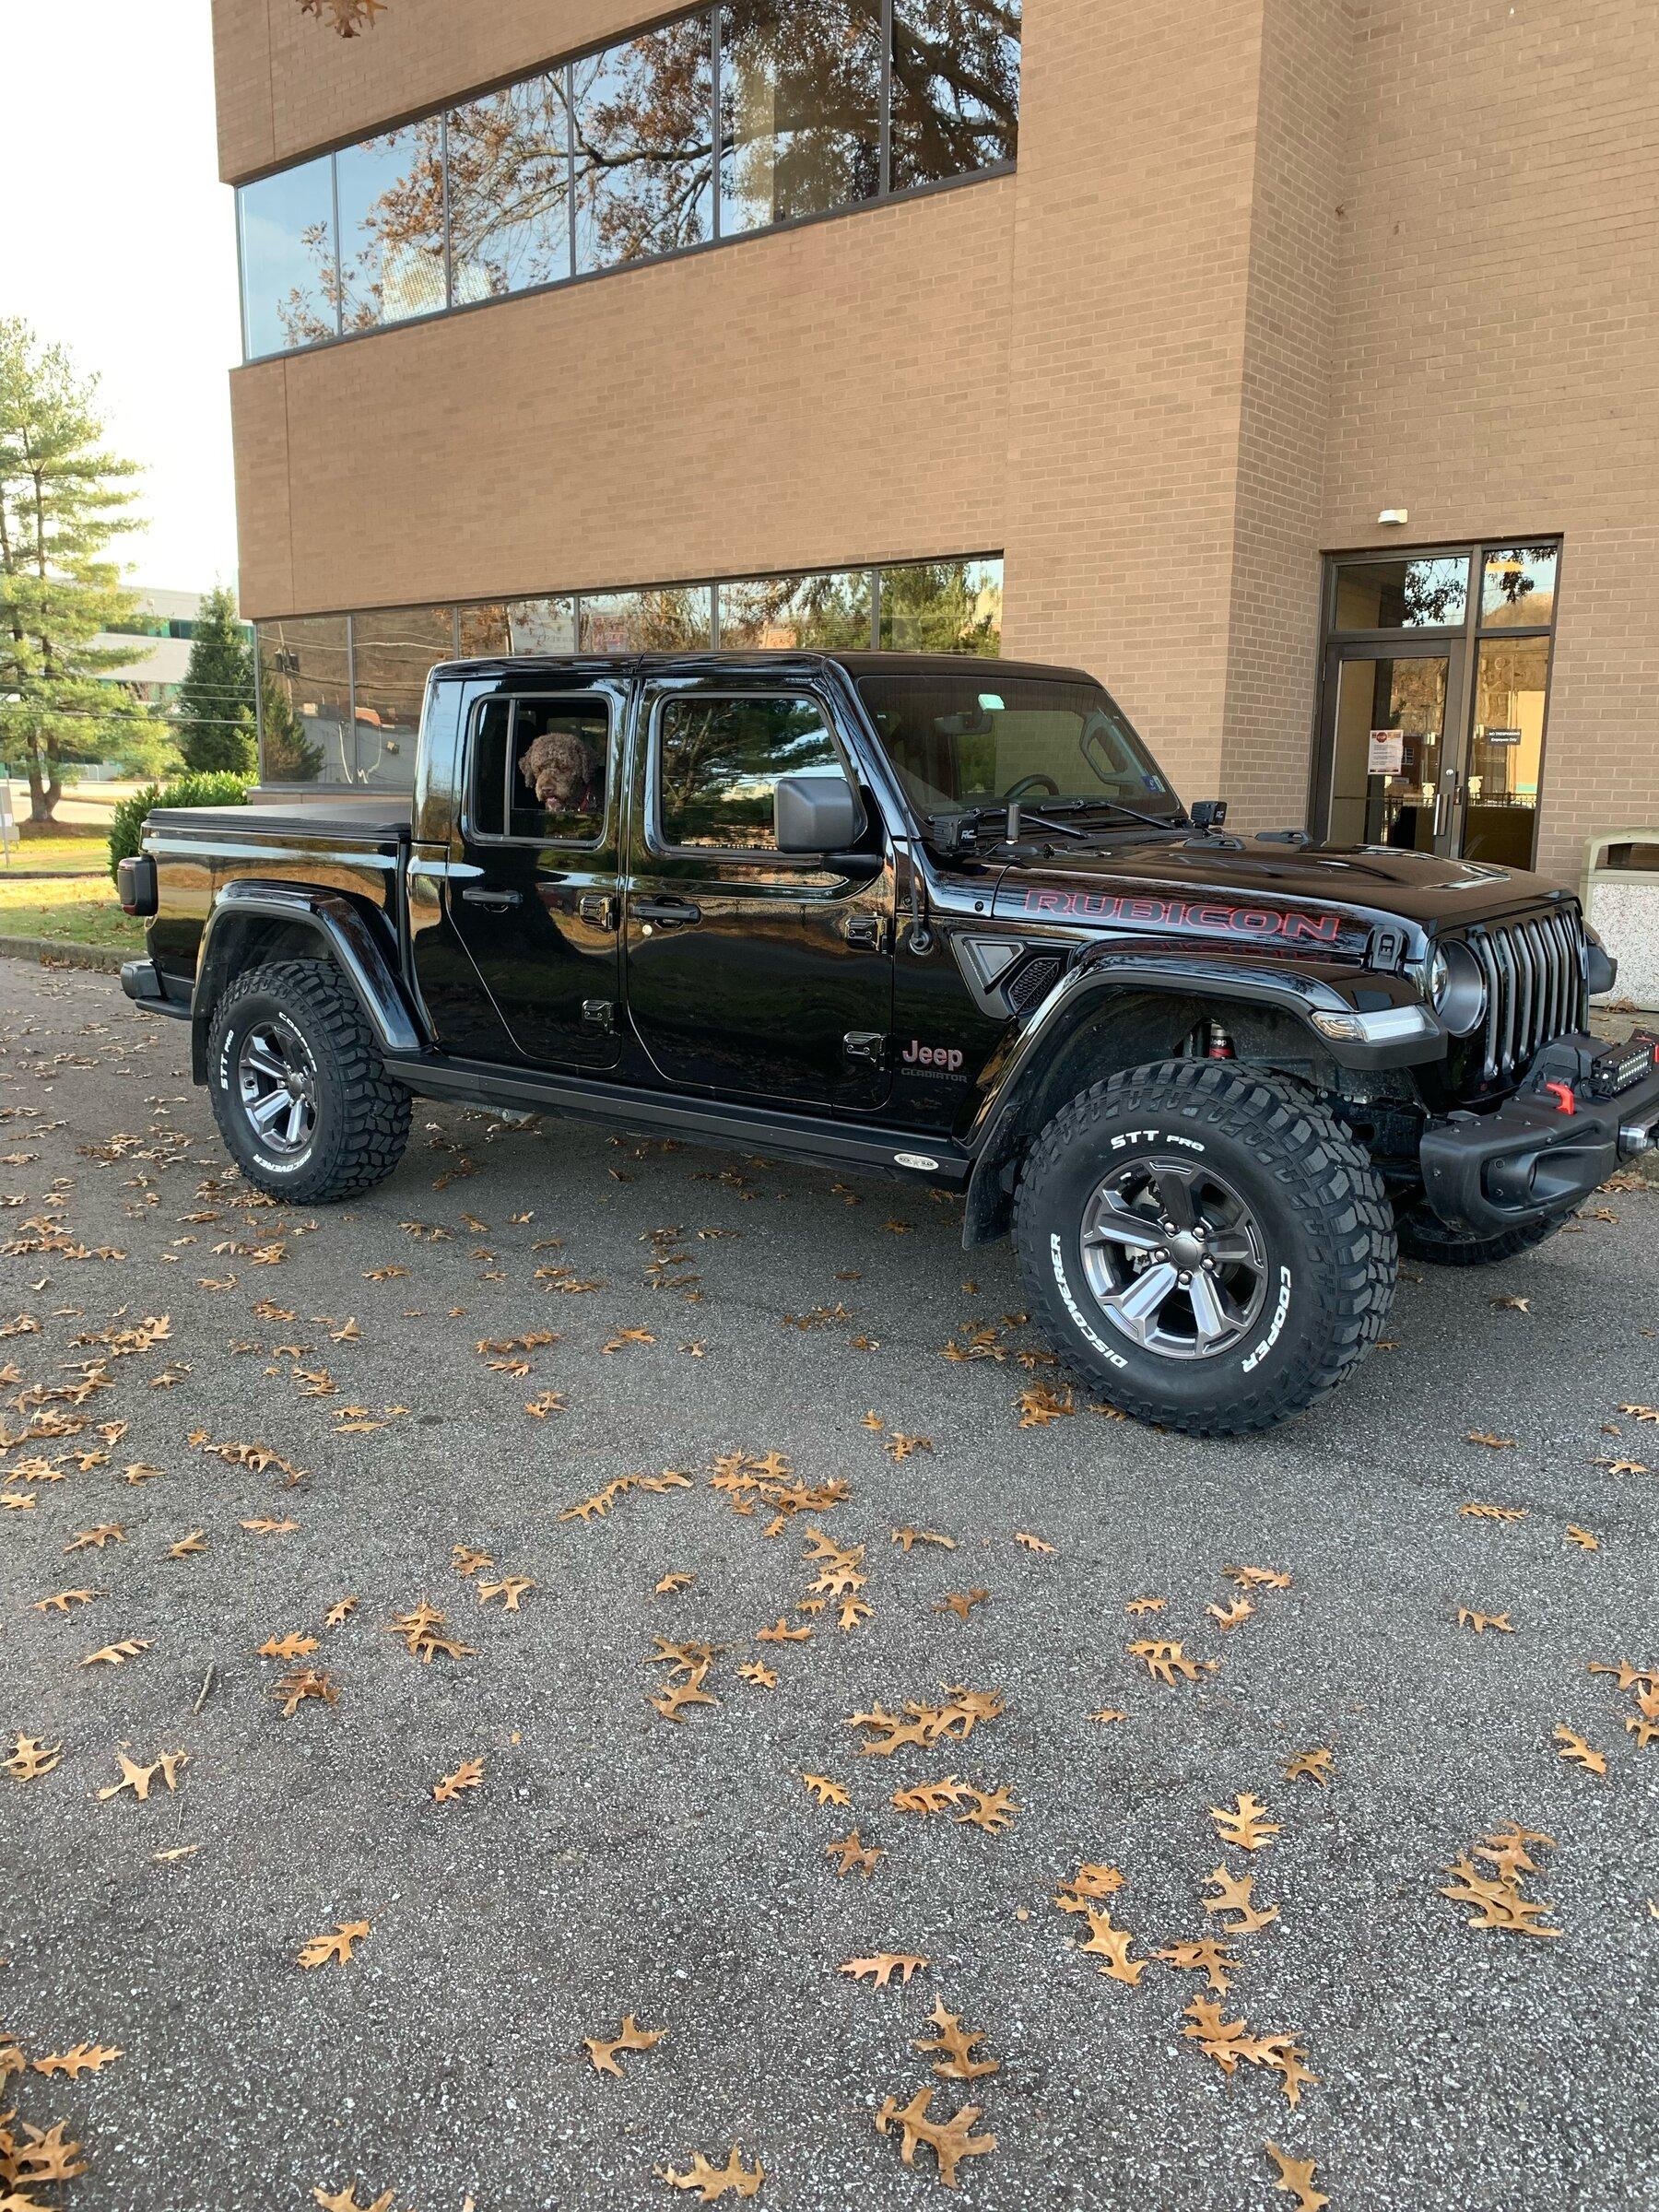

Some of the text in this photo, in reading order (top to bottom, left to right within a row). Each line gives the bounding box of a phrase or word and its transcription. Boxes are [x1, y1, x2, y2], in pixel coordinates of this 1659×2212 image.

[960, 829, 978, 840] RC
[1024, 888, 1341, 941] RUBICON
[219, 1029, 235, 1091] STT PRO
[278, 1011, 318, 1073] COOPER
[901, 1040, 964, 1072] Jeep
[900, 1067, 969, 1084] GLADIATOR
[253, 1147, 312, 1173] DISCOVERER
[1110, 1129, 1206, 1153] STT PRO
[1050, 1232, 1129, 1369] DISCOVERER
[1241, 1265, 1292, 1373] COOPER
